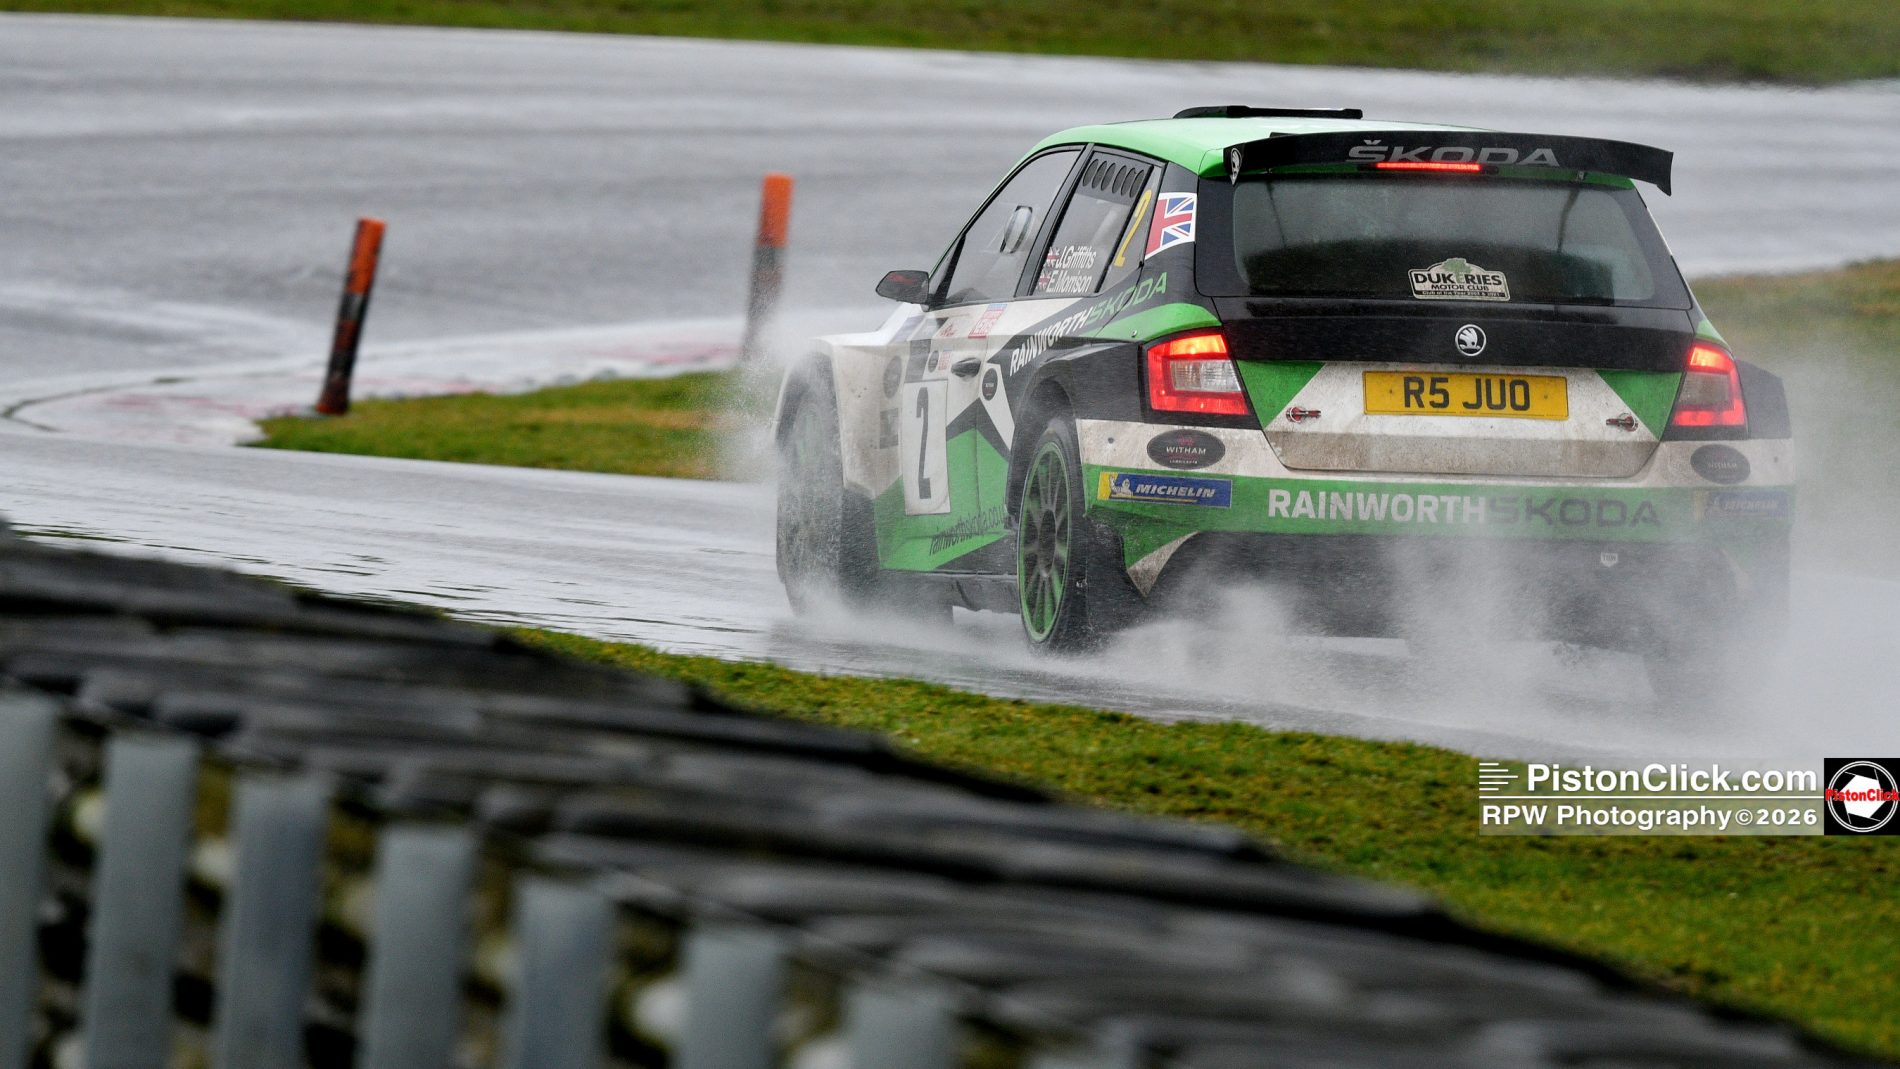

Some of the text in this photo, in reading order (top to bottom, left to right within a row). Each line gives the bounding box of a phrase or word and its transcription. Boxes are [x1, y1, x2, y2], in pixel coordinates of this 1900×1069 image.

[1345, 139, 1560, 167] ŠKODA
[1113, 189, 1152, 268] 2
[1413, 273, 1503, 286] DUKERIES
[1403, 376, 1531, 411] R5 JUO
[916, 387, 932, 499] 2
[1166, 446, 1207, 455] WITHAM
[1136, 484, 1217, 498] MICHELIN
